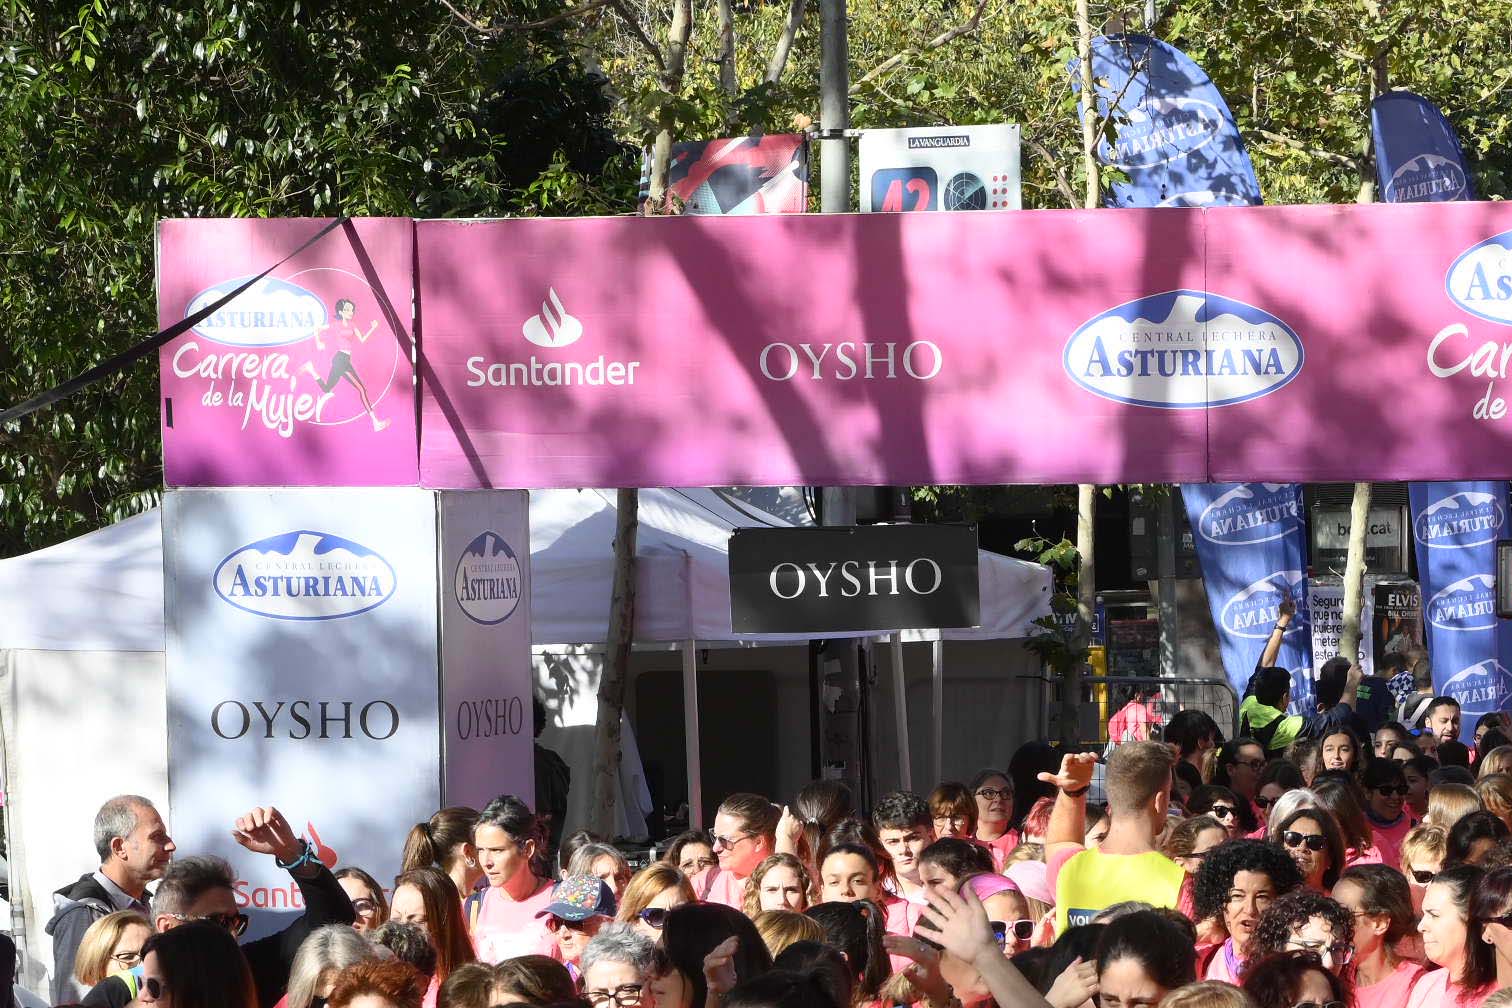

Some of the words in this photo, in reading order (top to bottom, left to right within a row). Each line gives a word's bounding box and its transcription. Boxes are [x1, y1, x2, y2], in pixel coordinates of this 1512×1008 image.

[910, 137, 919, 147] LA
[919, 136, 969, 147] VANGUARDIA
[1119, 331, 1194, 343] CENTRAL
[1202, 330, 1278, 342] LECHERA
[172, 341, 290, 379] Carrera
[465, 356, 640, 388] Santander
[758, 340, 943, 382] OYSHO
[1083, 335, 1286, 379] ASTURIANA
[201, 381, 224, 407] de
[228, 380, 244, 407] la
[241, 375, 335, 438] Mujer
[1472, 381, 1508, 420] de
[230, 563, 385, 599] ASTURIANA
[460, 566, 518, 602] ASTURIANA
[769, 556, 943, 600] OYSHO
[1388, 594, 1419, 606] ELVIS
[211, 700, 400, 741] OYSHO
[457, 696, 523, 741] OYSHO
